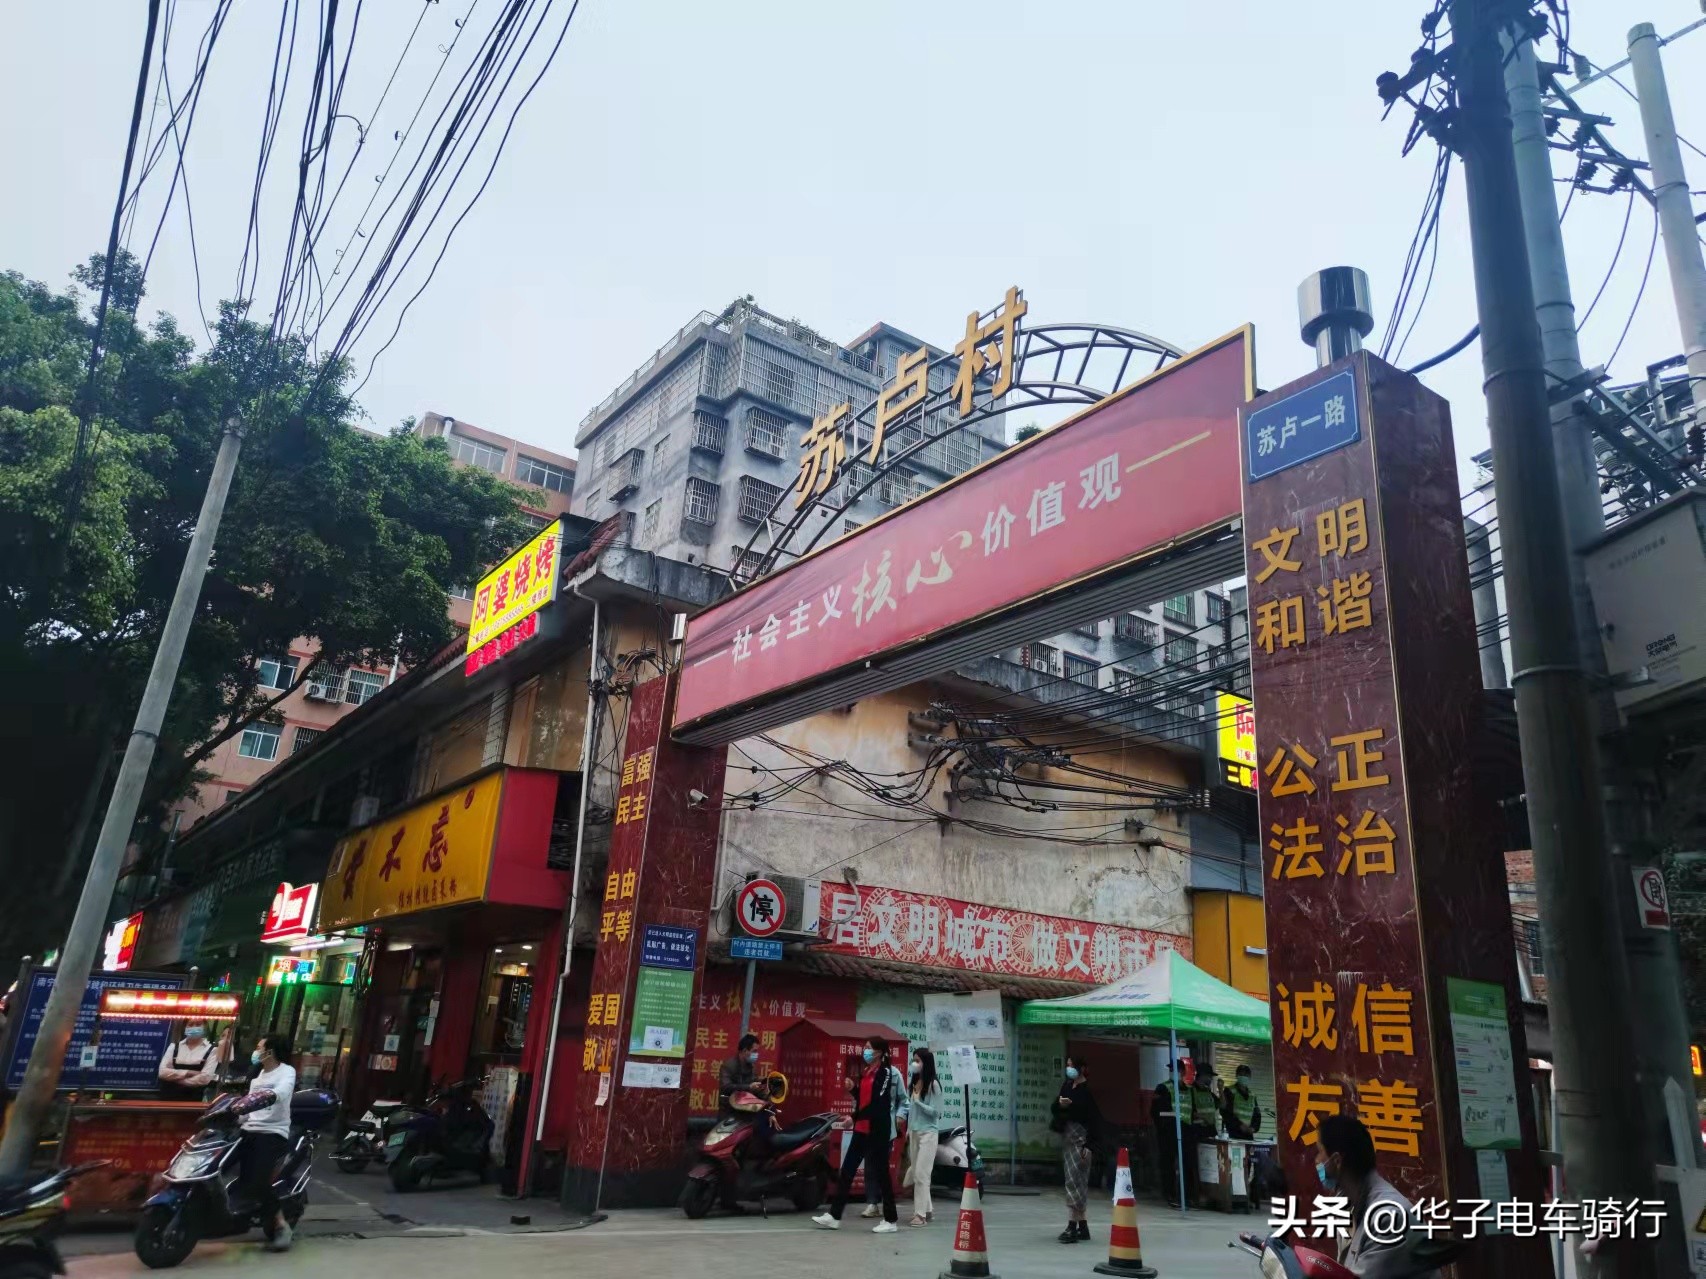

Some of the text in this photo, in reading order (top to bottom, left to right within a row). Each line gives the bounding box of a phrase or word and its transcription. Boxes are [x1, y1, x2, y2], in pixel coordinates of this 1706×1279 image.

[795, 286, 1028, 510] 苏卢村
[1256, 394, 1347, 457] 苏卢一路
[731, 453, 1121, 667] 社会主义核心价值观
[1252, 498, 1370, 585] 文明
[474, 536, 556, 629] 阿婆烧烤
[1256, 571, 1374, 654] 和谐
[621, 754, 652, 788] 富强
[1264, 729, 1390, 799] 公正
[615, 792, 646, 825] 民主
[1268, 809, 1397, 880] 法治
[605, 868, 637, 901] 自由
[749, 894, 774, 923] 停
[600, 910, 632, 943] 平等
[587, 993, 621, 1027] 爱国
[1276, 981, 1415, 1056] 诚信
[583, 1038, 612, 1073] 敬业
[1286, 1075, 1425, 1158] 友善
